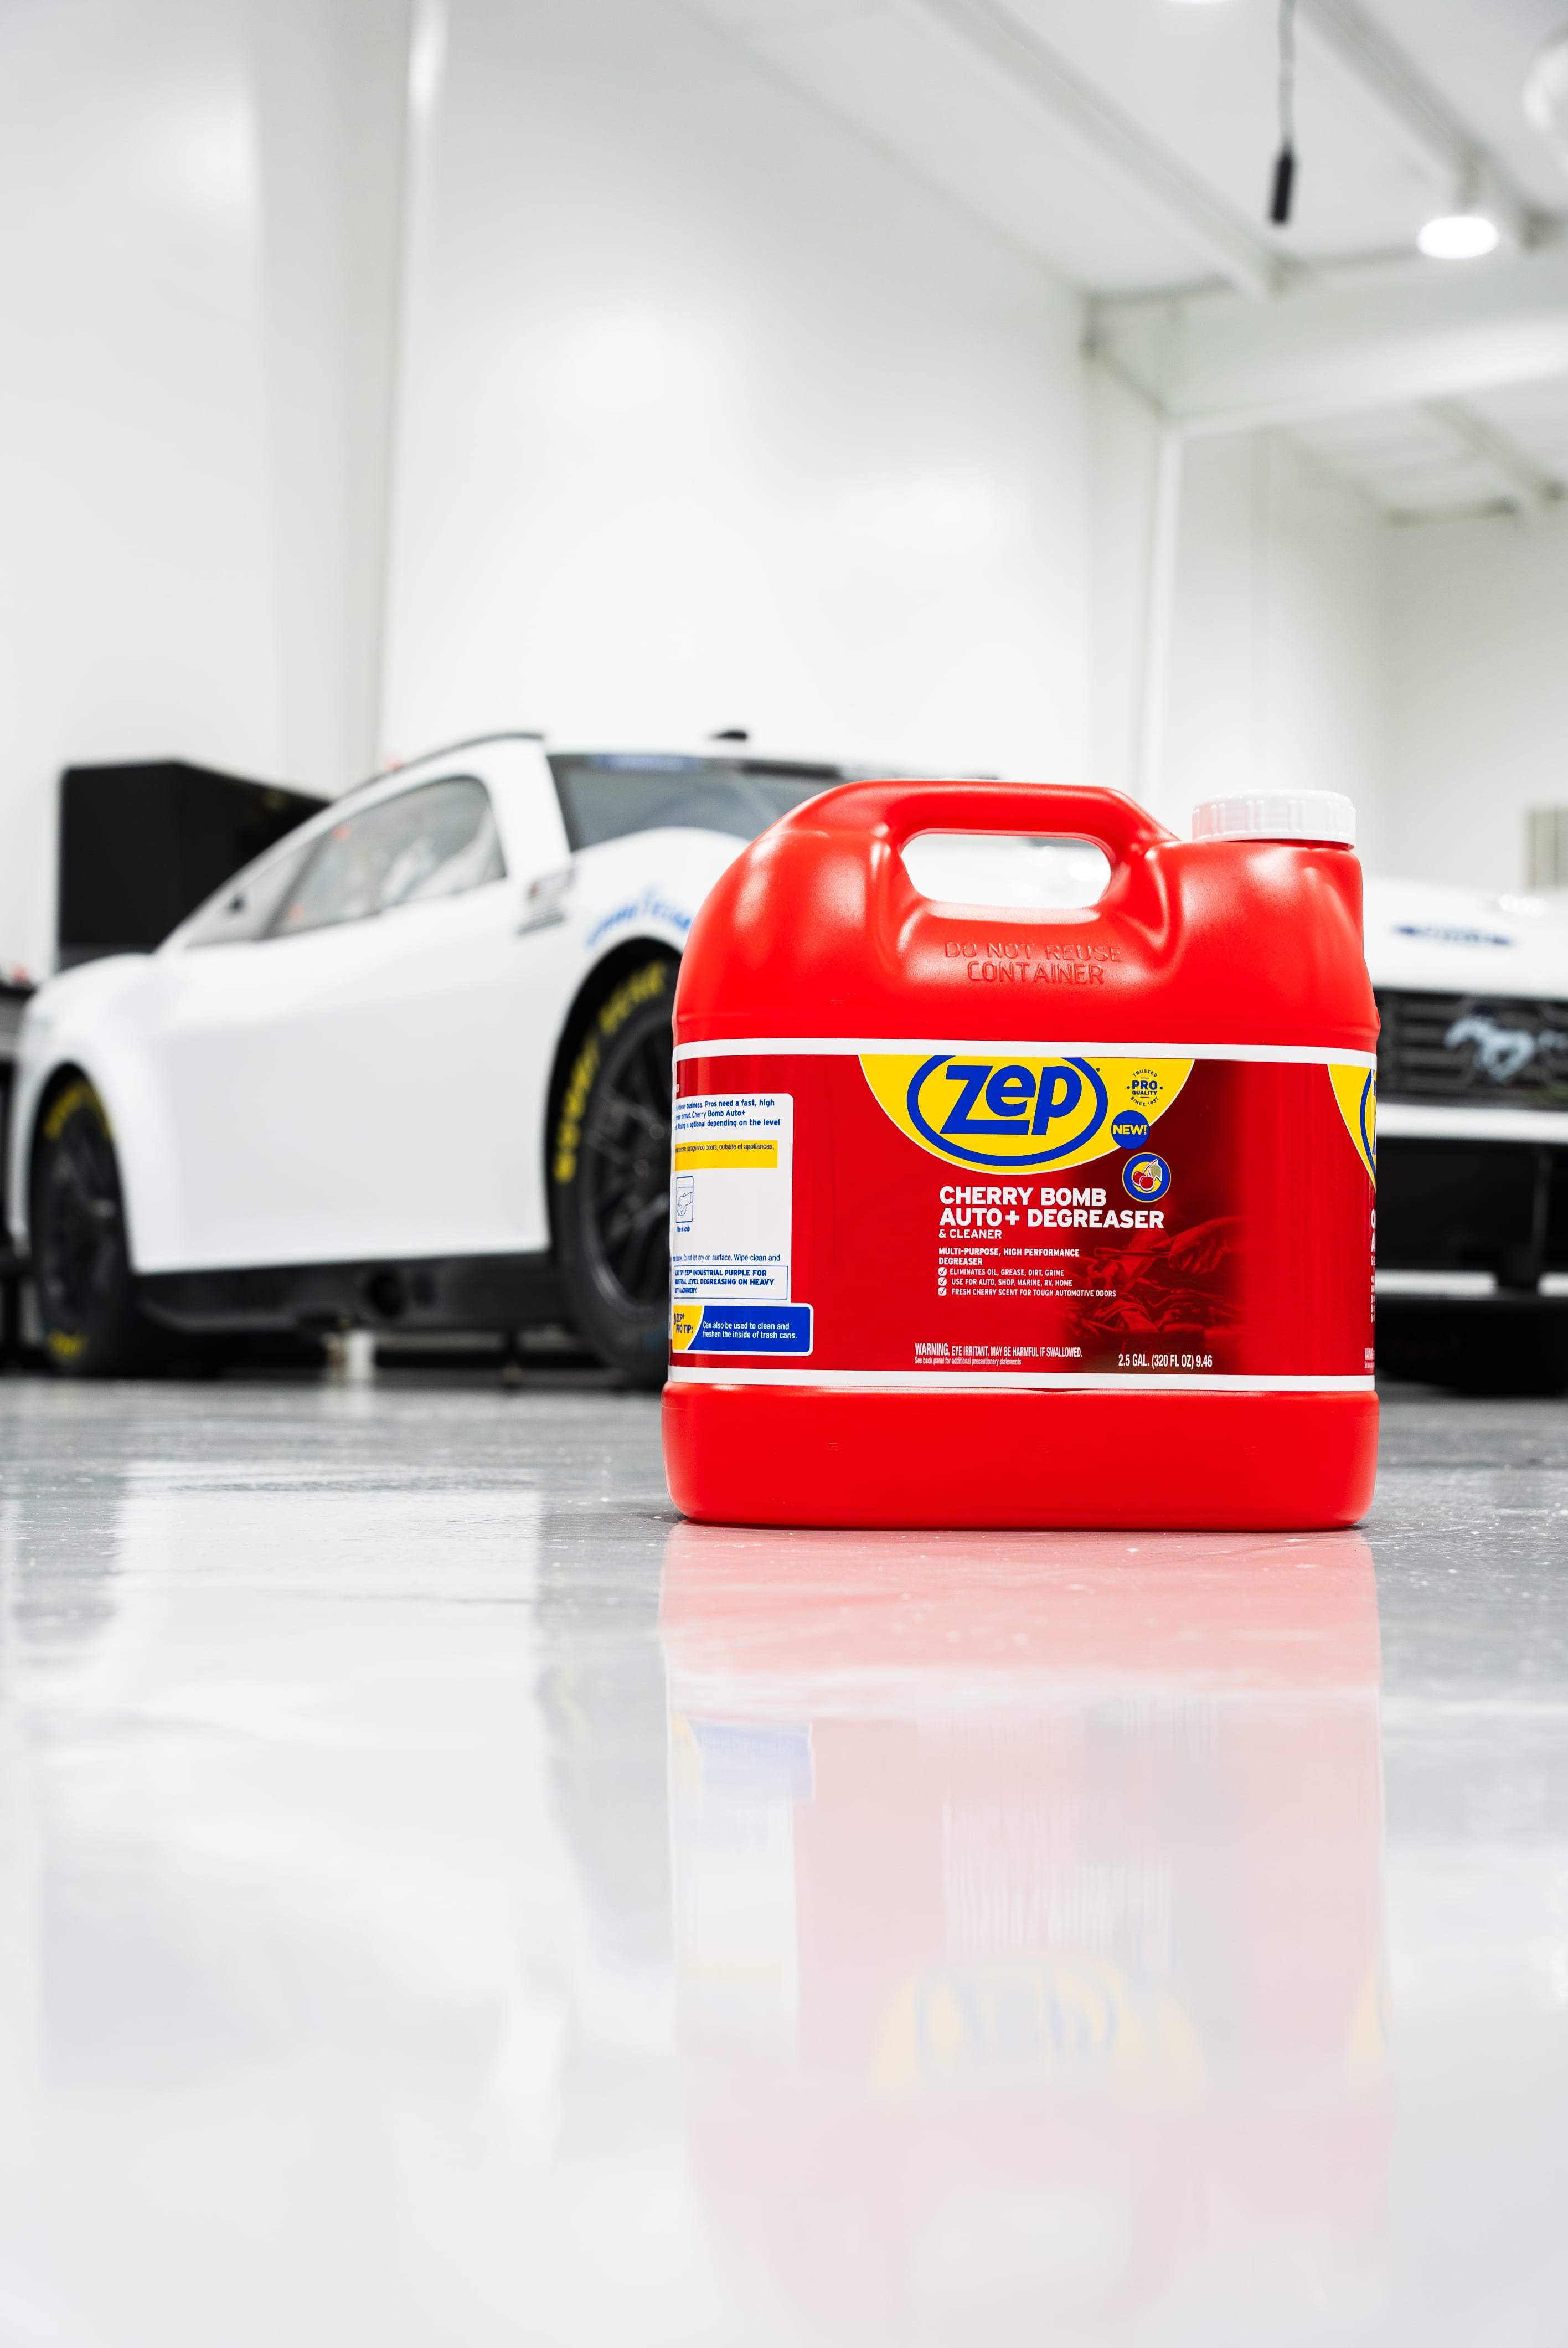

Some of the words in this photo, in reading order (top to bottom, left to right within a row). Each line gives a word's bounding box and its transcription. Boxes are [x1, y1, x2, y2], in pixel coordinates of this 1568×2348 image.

[945, 941, 977, 958] DO
[987, 943, 1034, 960] NOT
[1045, 944, 1123, 962] REUSE
[967, 961, 1105, 984] CONTAINER
[1132, 1080, 1158, 1090] PRO
[759, 1099, 775, 1107] high
[1130, 1096, 1146, 1106] SINCE
[1148, 1096, 1159, 1106] 1937
[690, 1120, 705, 1129] optional
[707, 1119, 737, 1127] depending
[1113, 1124, 1147, 1135] NEW!
[744, 1143, 775, 1151] appliances,
[939, 1186, 1034, 1206] CHERRY
[1041, 1187, 1107, 1206] BOMB
[1028, 1209, 1164, 1228] DEGREASER
[939, 1229, 946, 1238] &
[949, 1229, 1002, 1239] CLEANER
[938, 1247, 1001, 1256] MULTI-PURPOSE,
[1024, 1248, 1080, 1257] PERFORMANCE
[734, 1254, 748, 1262] Wipe
[683, 1325, 693, 1333] TIP:
[915, 1343, 950, 1356] WARNING.
[952, 1346, 962, 1356] EYE
[963, 1346, 989, 1356] IRRITANT.
[991, 1346, 1002, 1356] MAY
[1004, 1347, 1011, 1356] BE
[1013, 1347, 1039, 1357] HARMFUL
[1040, 1347, 1045, 1357] IF
[1046, 1347, 1082, 1358] SWALLOWED.
[972, 1358, 999, 1366] precautionary
[1118, 1353, 1130, 1367] 2.5
[1132, 1353, 1149, 1367] GAL.
[1152, 1354, 1168, 1369] (320
[1170, 1354, 1179, 1367] FL
[1181, 1354, 1194, 1370] OZ)
[1196, 1355, 1213, 1367] 9.46
